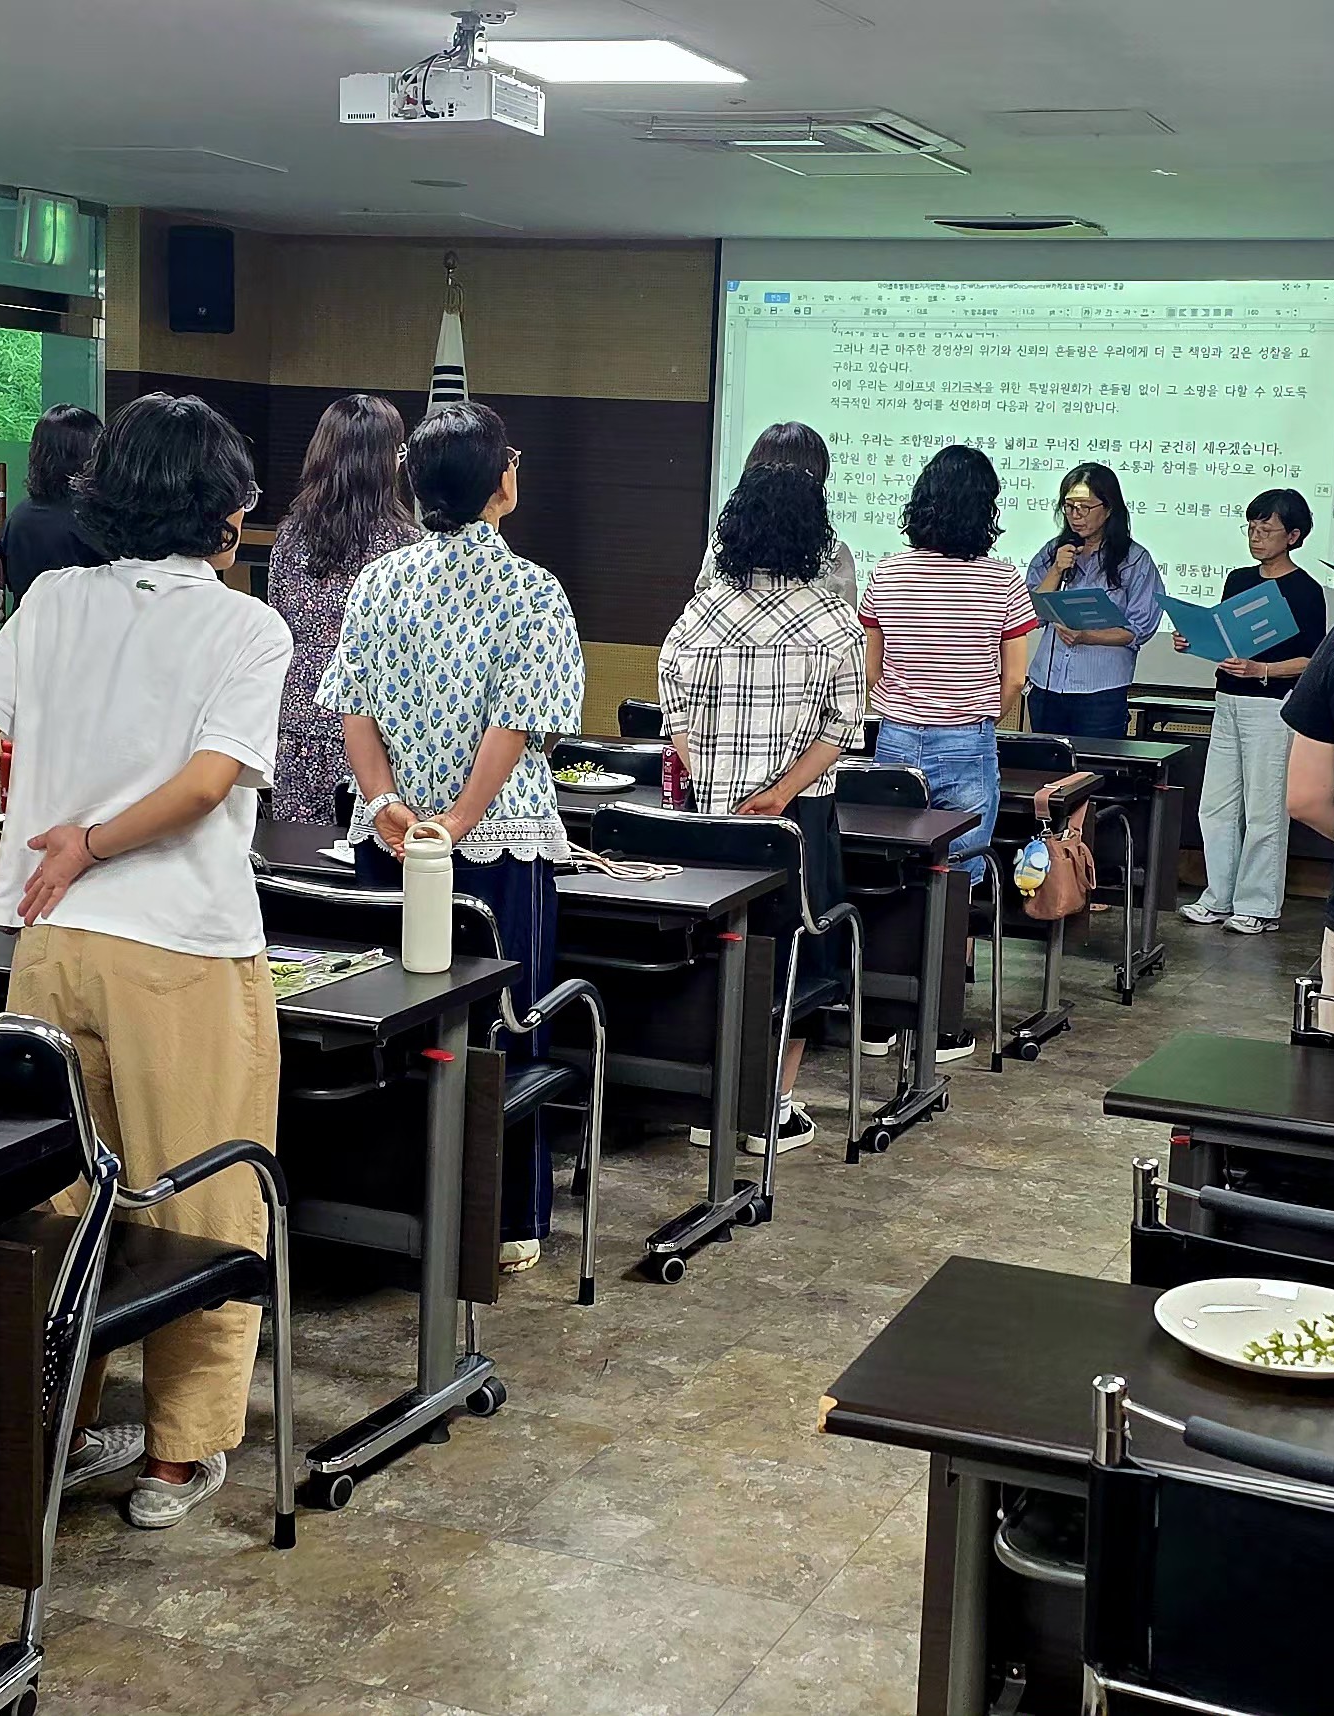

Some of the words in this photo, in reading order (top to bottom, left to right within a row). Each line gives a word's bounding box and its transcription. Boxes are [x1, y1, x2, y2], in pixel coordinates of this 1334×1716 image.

[832, 343, 865, 356] 그러나
[868, 343, 891, 356] 최근
[895, 344, 927, 356] 마주한
[931, 344, 974, 357] 경영상의
[979, 344, 1012, 357] 위기와
[1016, 344, 1049, 357] 신뢰의
[1054, 345, 1099, 358] 흔들림은
[1103, 345, 1149, 358] 우리에게
[1154, 345, 1165, 359] 더
[1171, 346, 1183, 359] 큰
[1188, 346, 1223, 359] 책임과
[1229, 346, 1252, 359] 깊은
[1258, 346, 1292, 360] 성찰을
[1298, 347, 1311, 360] 요
[832, 360, 864, 374] 구하고
[867, 360, 913, 374] 있습니다.
[831, 378, 852, 391] 이에
[856, 379, 889, 392] 우리는
[893, 380, 936, 392] 세이프넷
[940, 380, 994, 393] 위기극복을
[999, 381, 1021, 394] 위한
[1027, 382, 1093, 395] 특별위원회가
[1098, 382, 1132, 396] 흔들림
[1138, 383, 1160, 397] 없이
[1165, 384, 1179, 395] 그
[1183, 384, 1218, 397] 소명을
[1225, 384, 1248, 398] 다할
[1253, 385, 1266, 399] 수
[1272, 385, 1308, 399] 있도록
[830, 396, 871, 410] 적극적인
[875, 397, 907, 410] 지지와
[913, 397, 944, 411] 참여를
[948, 398, 992, 412] 선언하며
[996, 399, 1029, 413] 다음과
[1034, 400, 1056, 413] 같이
[1061, 401, 1119, 414] 결의합니다.
[828, 431, 854, 445] 하나.
[859, 432, 895, 446] 우리는
[963, 435, 998, 449] 소통을
[1003, 436, 1039, 450] 넓히고
[1044, 437, 1080, 451] 무너진
[1086, 438, 1123, 453] 신뢰를
[1129, 439, 1153, 454] 다시
[1158, 440, 1196, 455] 굳건히
[1202, 442, 1283, 457] 세우겠습니다.
[830, 452, 860, 466] 조합원
[866, 452, 878, 466] 한
[883, 453, 896, 467] 분
[901, 453, 913, 467] 한
[918, 454, 929, 468] 분
[999, 456, 1012, 470] 귀
[1118, 460, 1155, 474] 소통과
[1161, 461, 1199, 475] 참여를
[1204, 462, 1256, 477] 바탕으로
[1263, 464, 1303, 478] 아이쿱
[842, 472, 876, 486] 주인이
[882, 473, 916, 487] 누구인
[827, 490, 859, 504] 신뢰는
[866, 492, 910, 506] 한순간에
[996, 496, 1019, 510] 리의
[1154, 502, 1168, 513] 그
[1174, 502, 1212, 516] 신뢰를
[854, 549, 876, 563] 리는
[1178, 584, 1216, 598] 그리고
